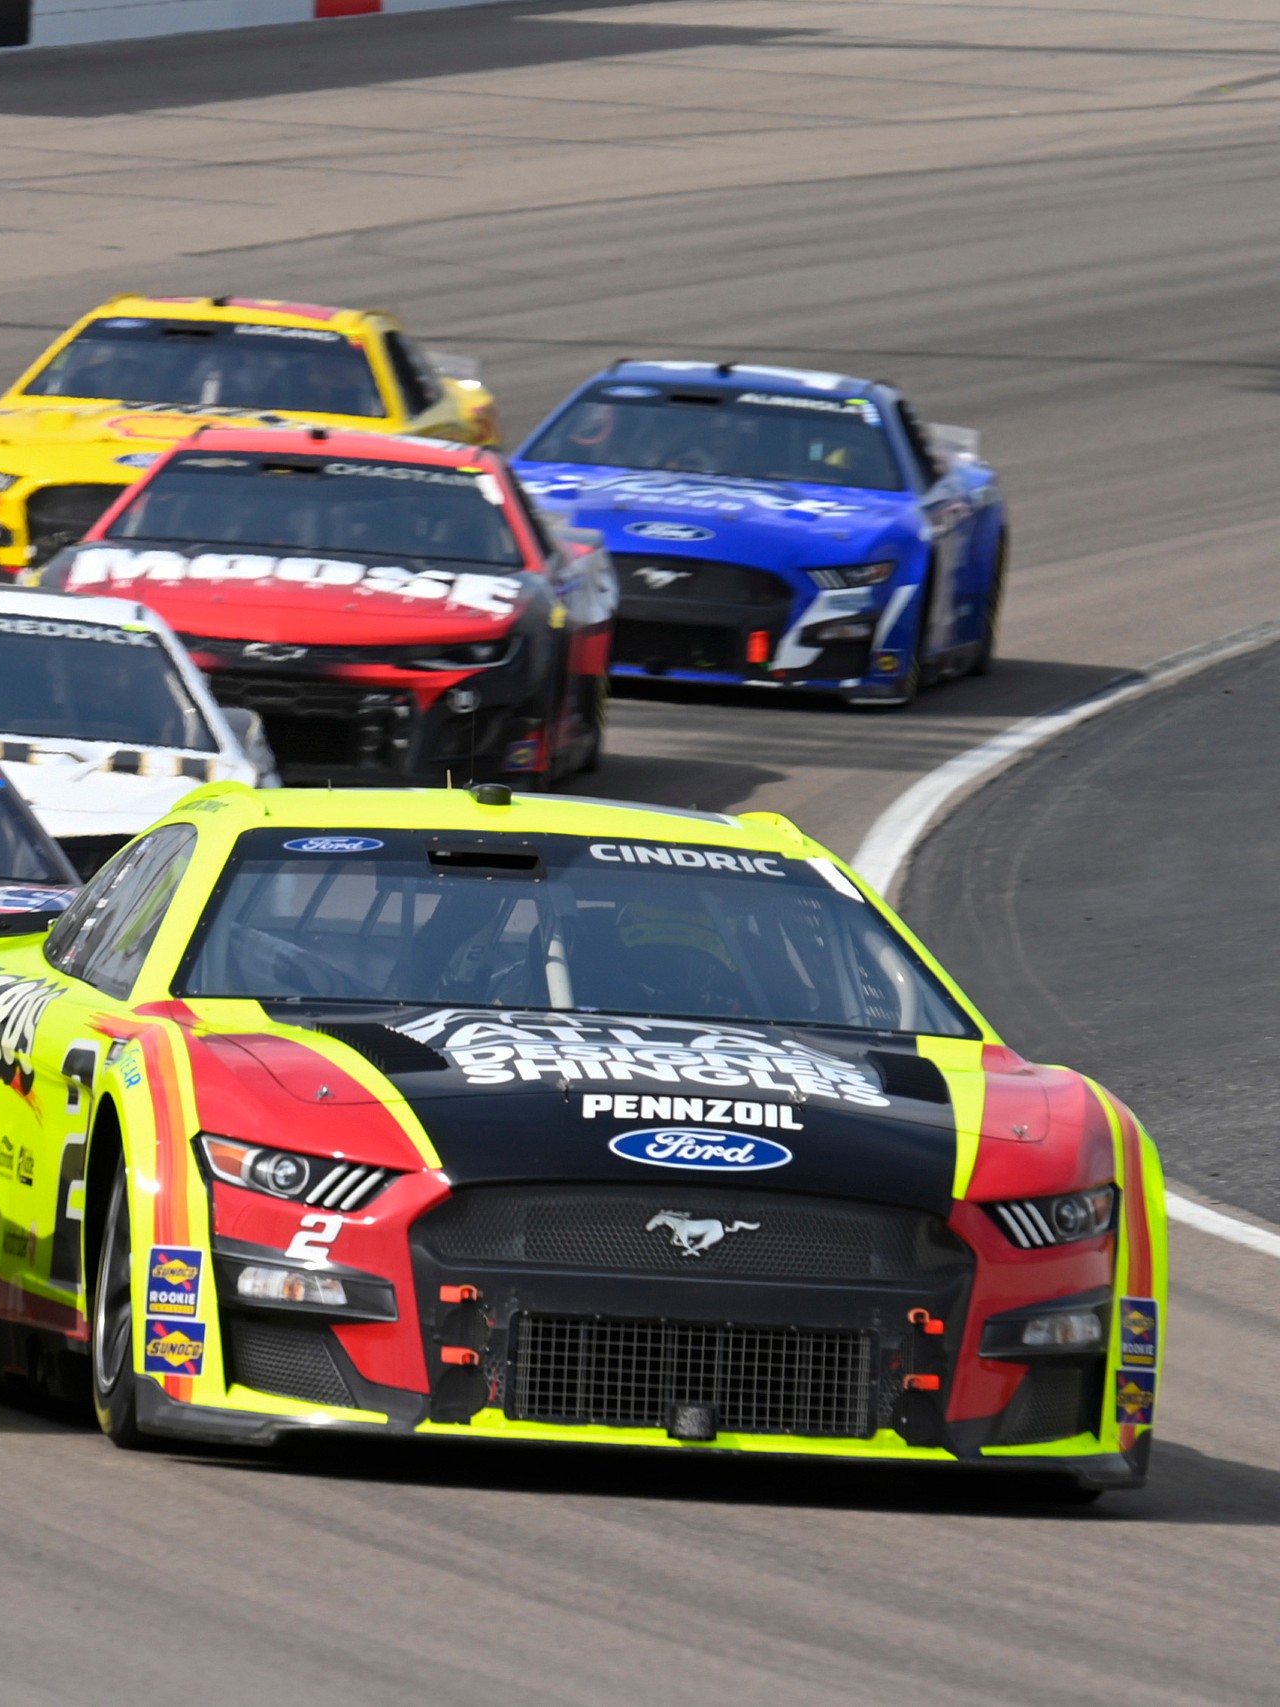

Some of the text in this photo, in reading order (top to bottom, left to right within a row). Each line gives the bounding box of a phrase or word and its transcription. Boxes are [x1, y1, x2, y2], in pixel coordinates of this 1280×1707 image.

[66, 548, 523, 615] MOOSE
[300, 837, 365, 852] Ford
[589, 843, 786, 877] CINDRIC
[452, 1043, 876, 1086] DESIGNER
[465, 1059, 891, 1107] SHINGLES
[582, 1094, 804, 1131] PENNZOIL
[645, 1131, 756, 1165] Ford
[284, 1214, 344, 1266] 2
[154, 1265, 197, 1280] SUNOCO
[149, 1290, 197, 1306] ROOKIE
[151, 1341, 203, 1358] SUNOCO
